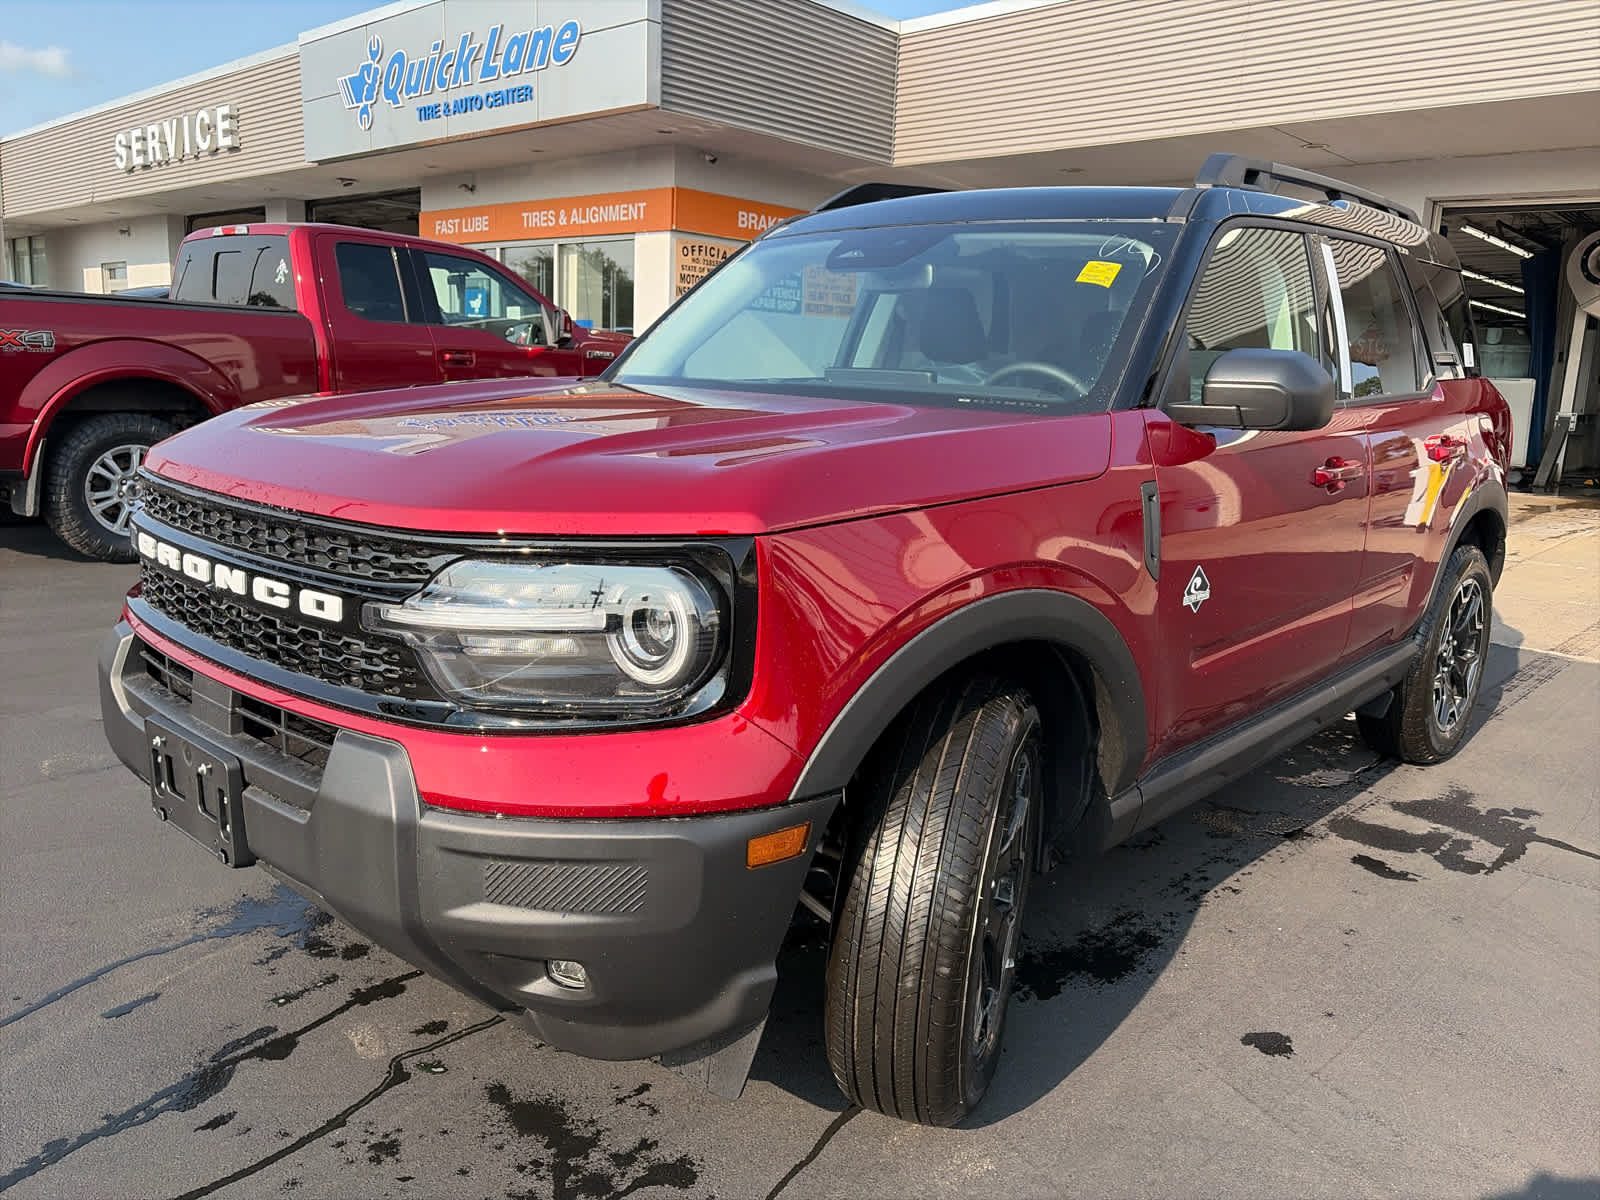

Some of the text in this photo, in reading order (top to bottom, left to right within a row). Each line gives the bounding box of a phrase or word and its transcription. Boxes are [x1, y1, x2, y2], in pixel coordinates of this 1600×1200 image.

[382, 18, 582, 109] Quick Lane
[416, 84, 534, 122] TIRE & AUTO CENTER
[114, 104, 240, 171] SERVICE
[435, 215, 489, 235] FAST LUBE
[521, 202, 647, 228] TIRES & ALIGNMENT
[138, 531, 343, 623] BRONCO
